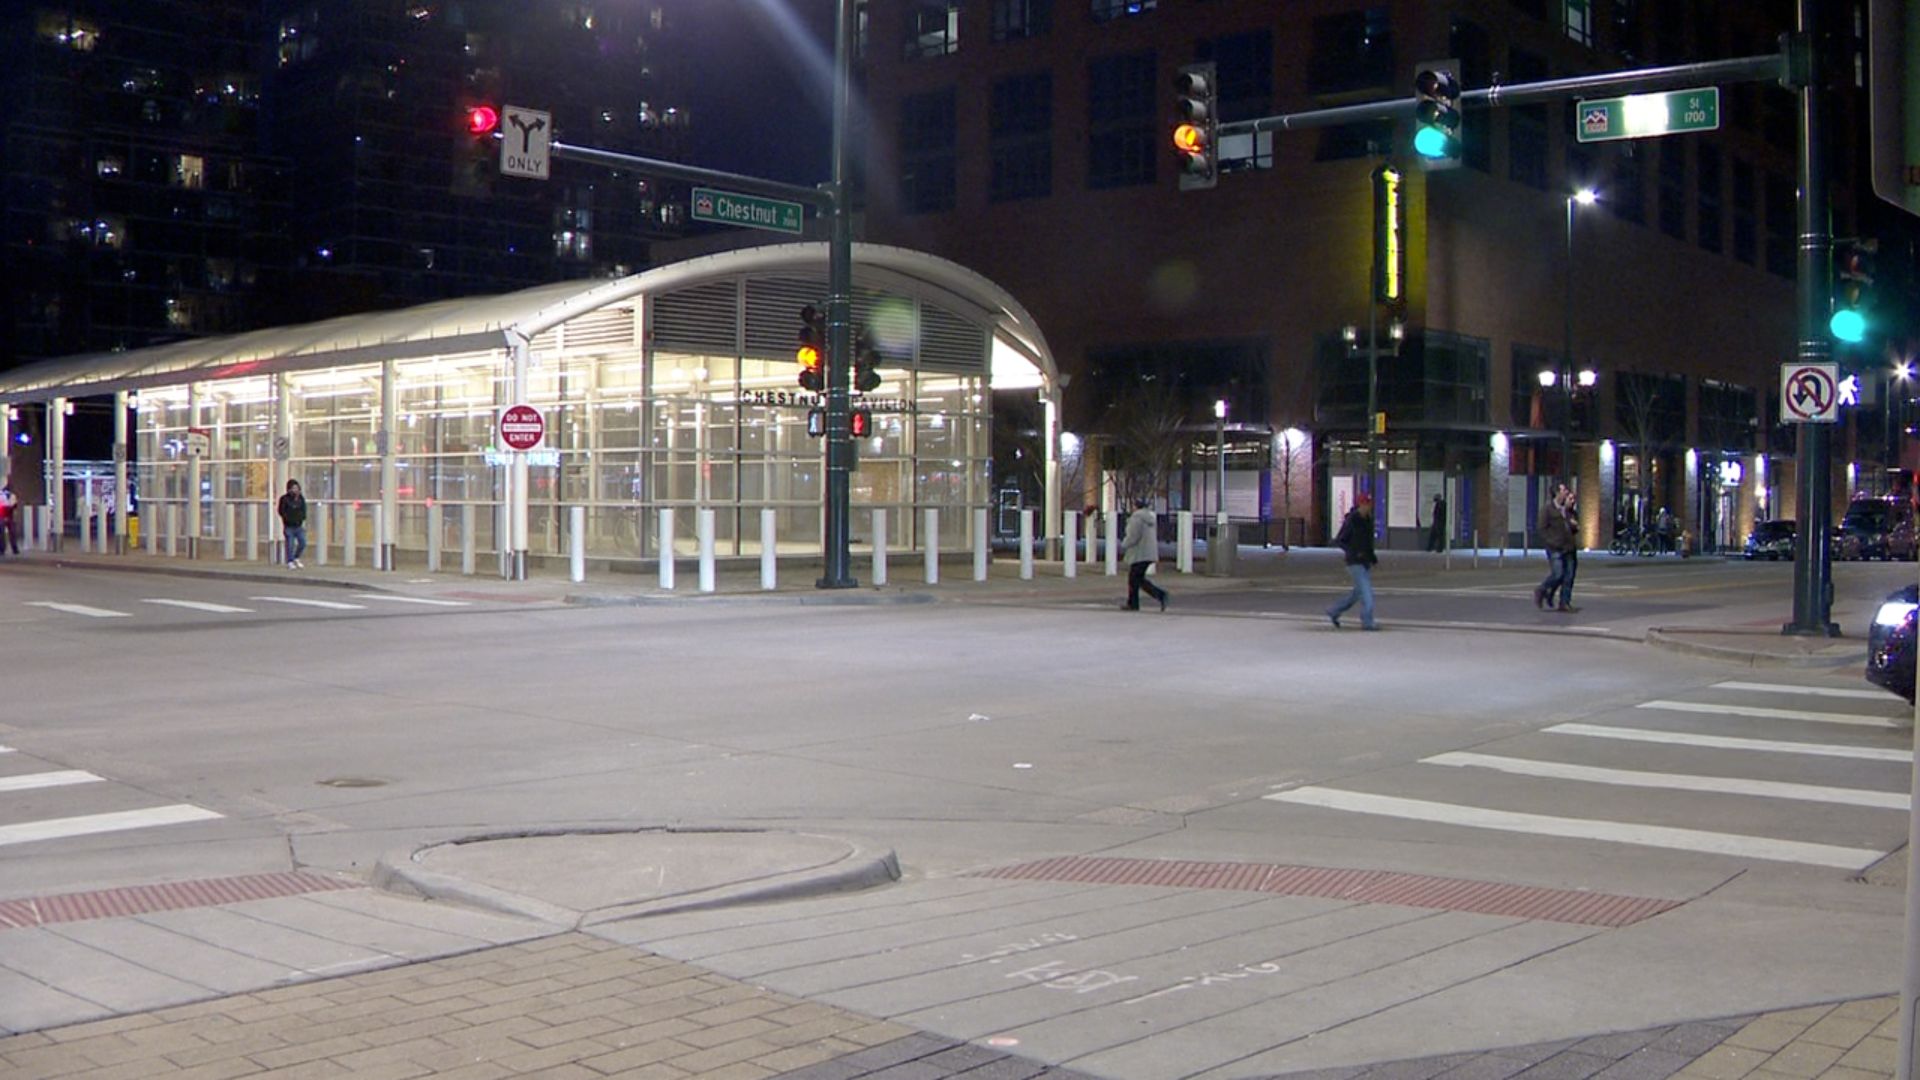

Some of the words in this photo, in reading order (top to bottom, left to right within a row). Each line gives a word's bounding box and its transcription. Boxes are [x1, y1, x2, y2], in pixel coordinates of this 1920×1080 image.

[1684, 111, 1705, 122] 1700
[508, 155, 542, 172] ONLY
[717, 197, 777, 225] Chestnut
[506, 412, 519, 422] DO
[521, 412, 538, 422] NOT
[509, 432, 535, 443] ENTER
